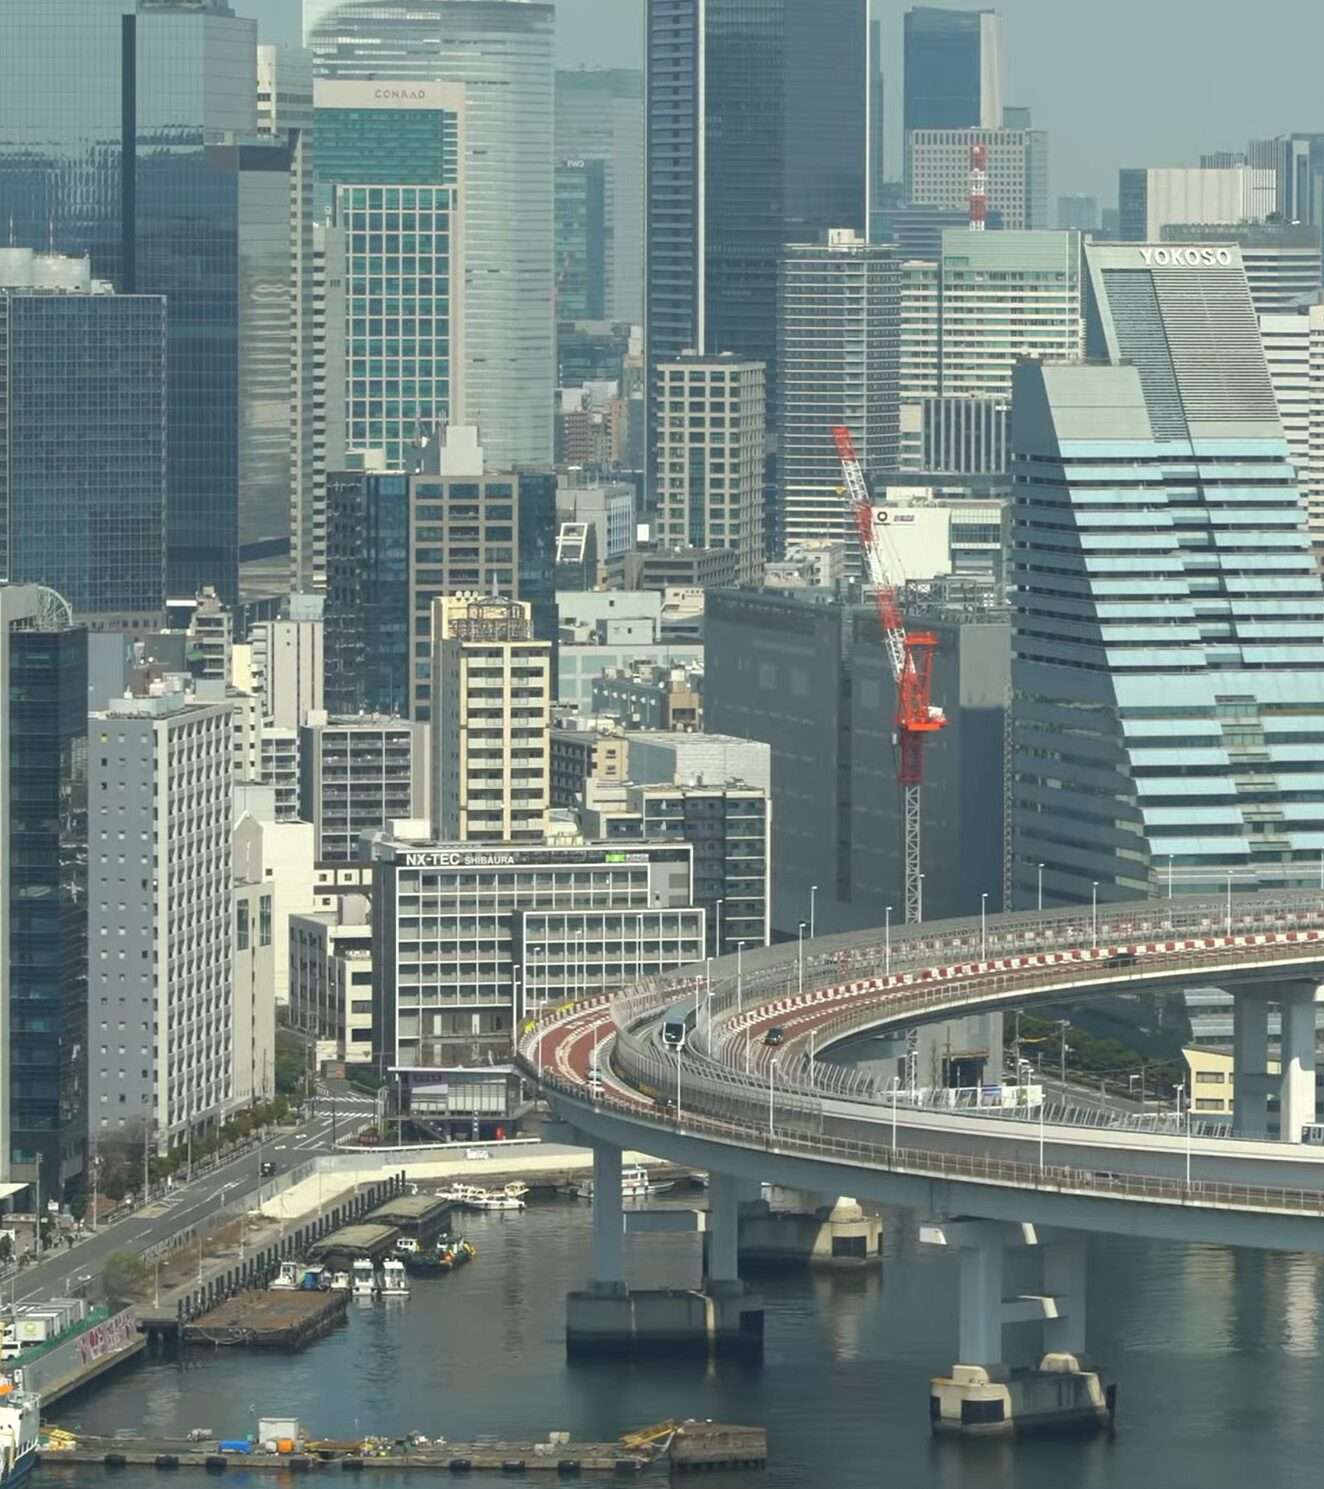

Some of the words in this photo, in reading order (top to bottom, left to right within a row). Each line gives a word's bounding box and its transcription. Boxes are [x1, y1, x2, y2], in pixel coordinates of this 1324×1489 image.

[375, 88, 425, 99] CONRAD
[1139, 247, 1232, 266] YOKOSO
[406, 853, 460, 866] NX-TEC
[464, 855, 514, 865] SHIBAURA
